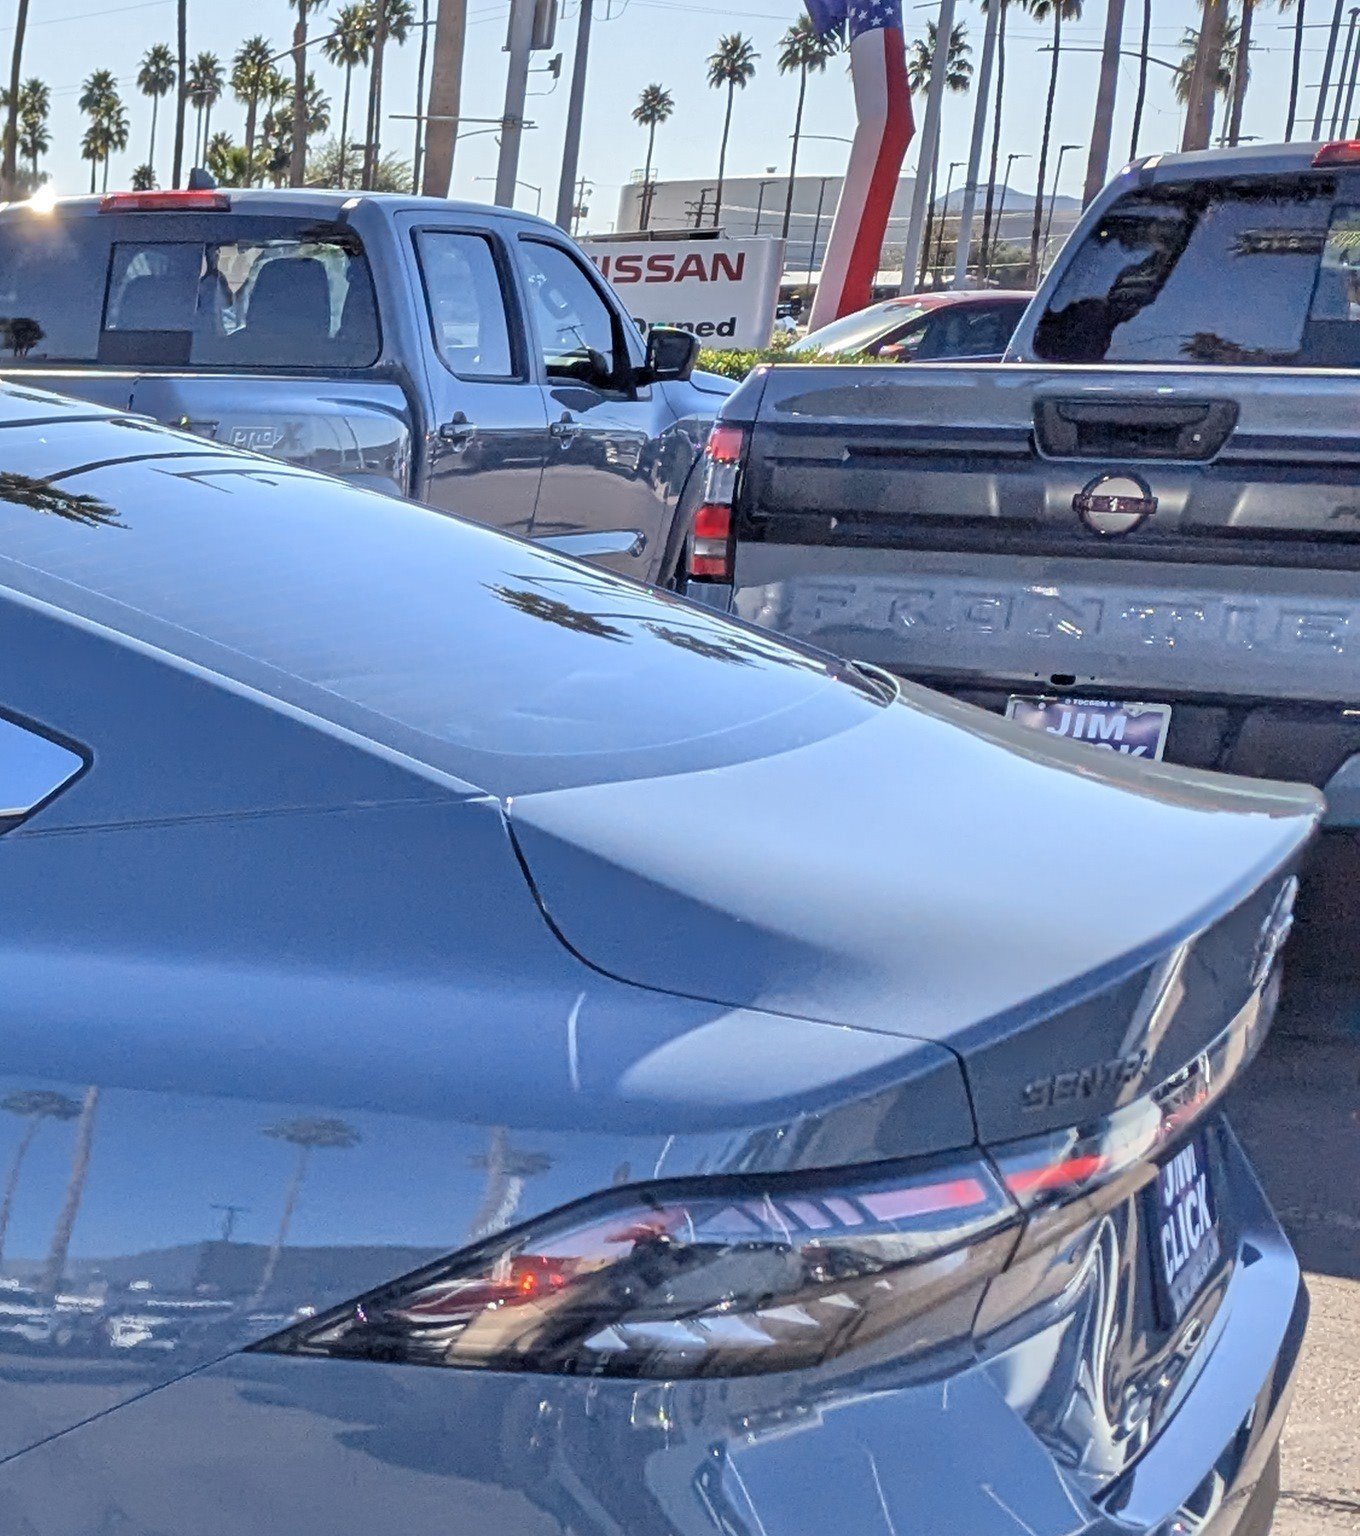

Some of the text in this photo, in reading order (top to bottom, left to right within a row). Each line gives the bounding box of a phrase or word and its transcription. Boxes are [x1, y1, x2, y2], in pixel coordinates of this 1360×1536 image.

[591, 252, 746, 284] ISSAN
[1046, 711, 1127, 741] JIM
[1164, 1143, 1197, 1207] JIM
[1161, 1172, 1212, 1285] CLICK
